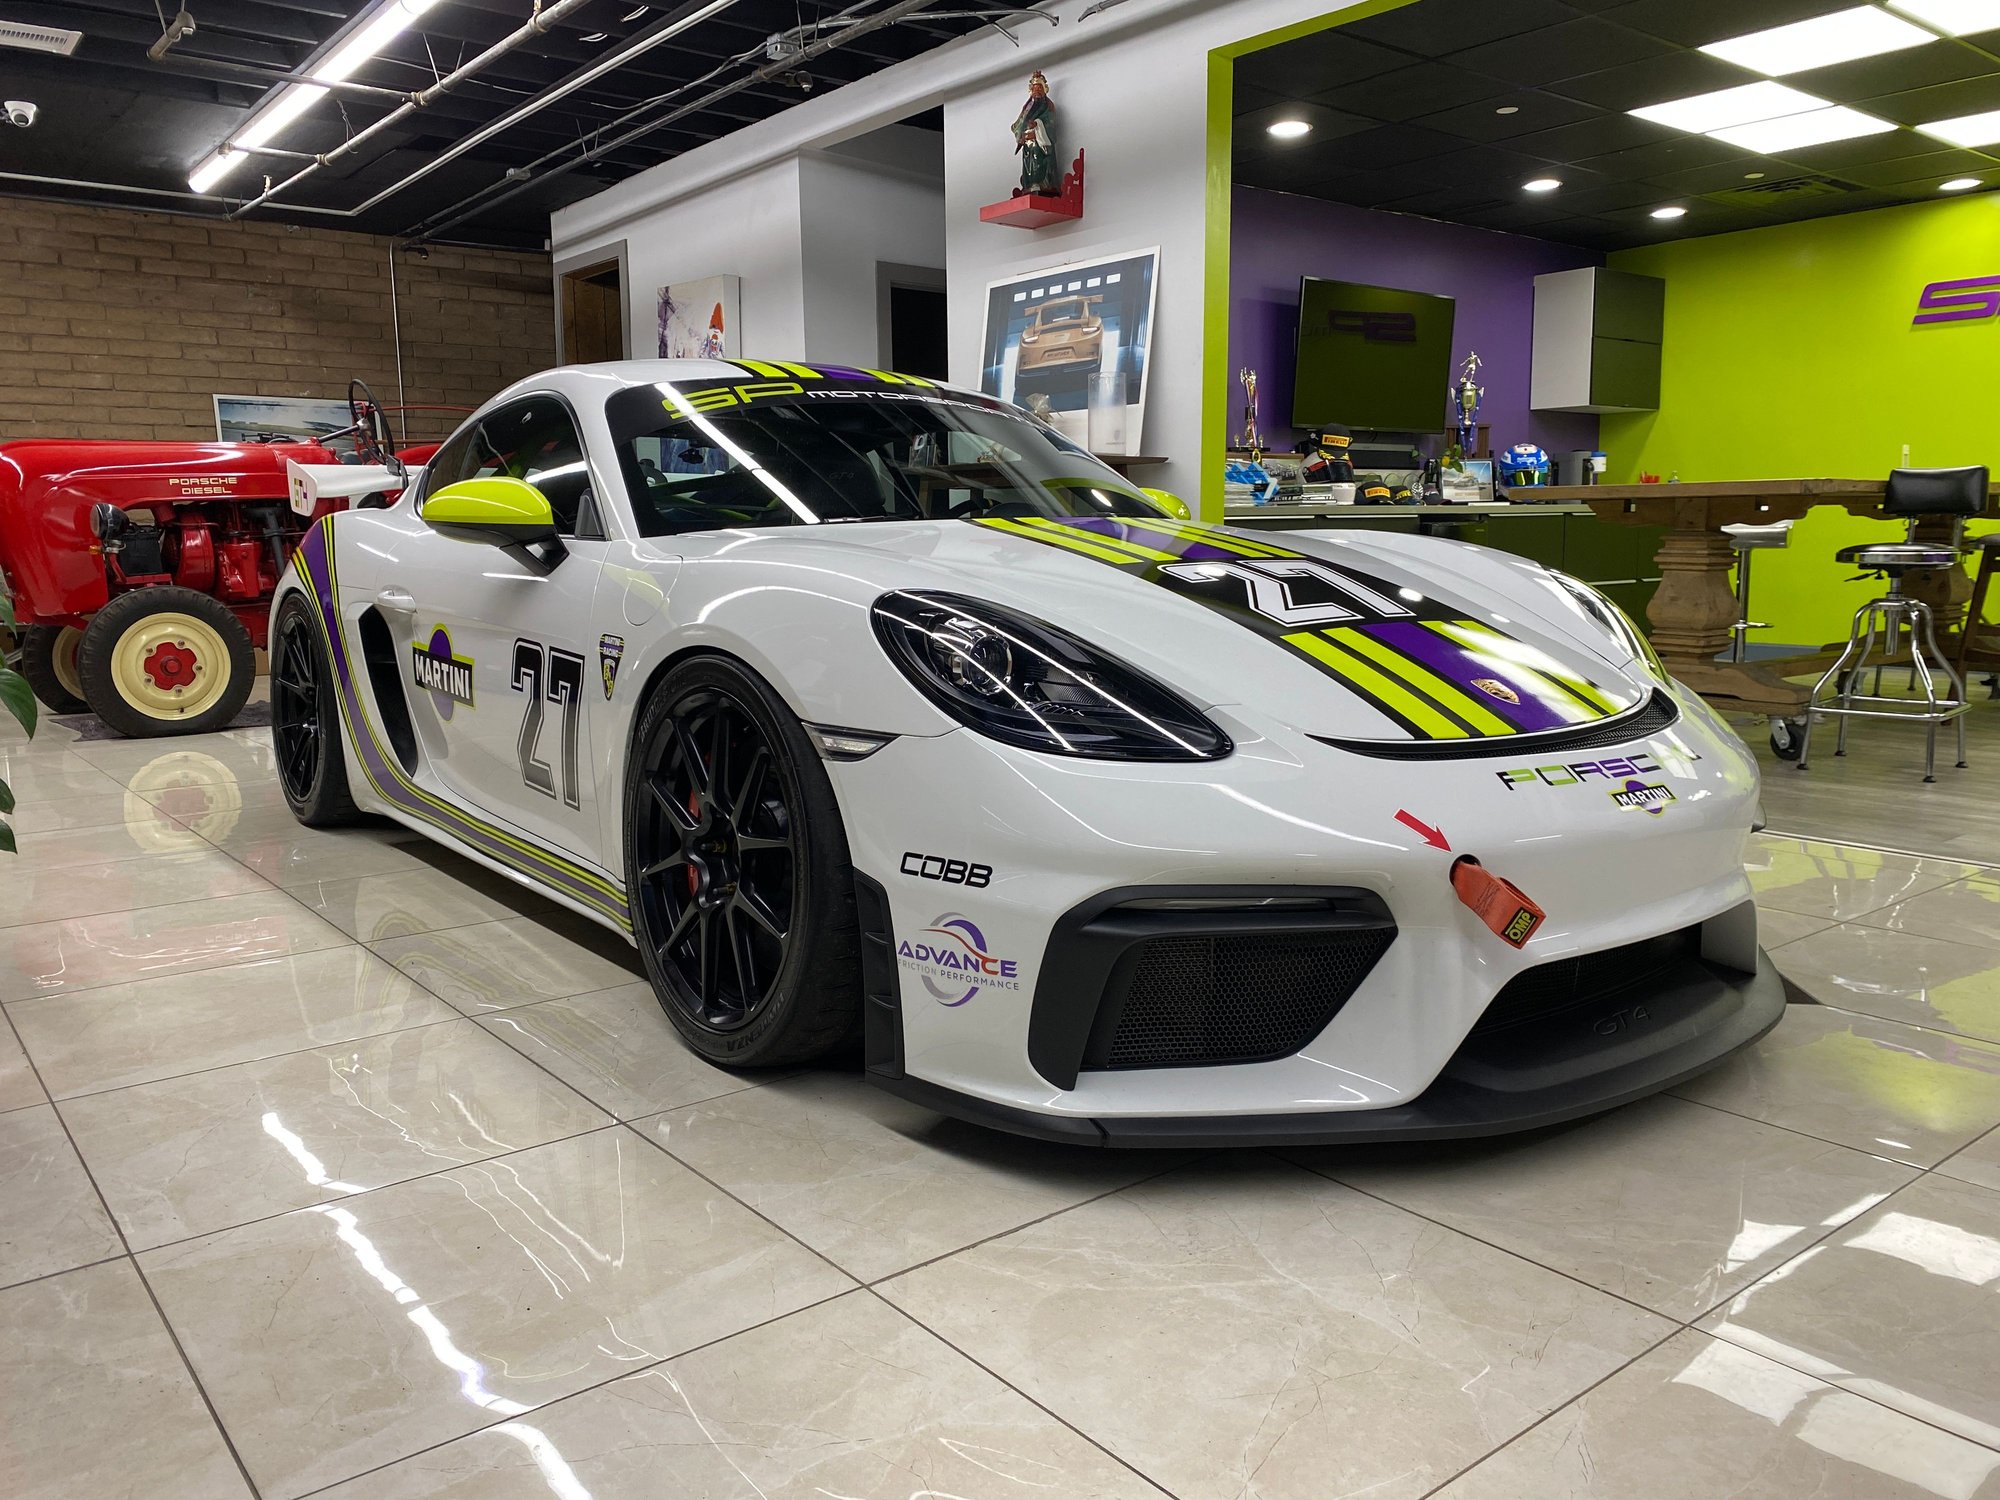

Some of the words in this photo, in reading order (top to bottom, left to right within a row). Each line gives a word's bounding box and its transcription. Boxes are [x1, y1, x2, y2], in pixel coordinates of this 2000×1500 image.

[1912, 274, 2000, 324] S
[662, 383, 804, 420] SP
[169, 477, 238, 486] PORSCHE
[182, 487, 232, 495] DIESEL
[1157, 559, 1416, 628] 27
[415, 653, 470, 700] MARTINI
[511, 637, 585, 812] 27
[1496, 748, 1703, 791] PORSC
[1615, 786, 1672, 806] MARTINI
[900, 852, 993, 888] COBB
[1509, 912, 1531, 940] OMP
[898, 940, 1018, 978] ADVANCE
[899, 958, 937, 975] FRICTION
[940, 969, 1020, 991] PERFORMANCE
[1593, 1006, 1651, 1035] GT4
